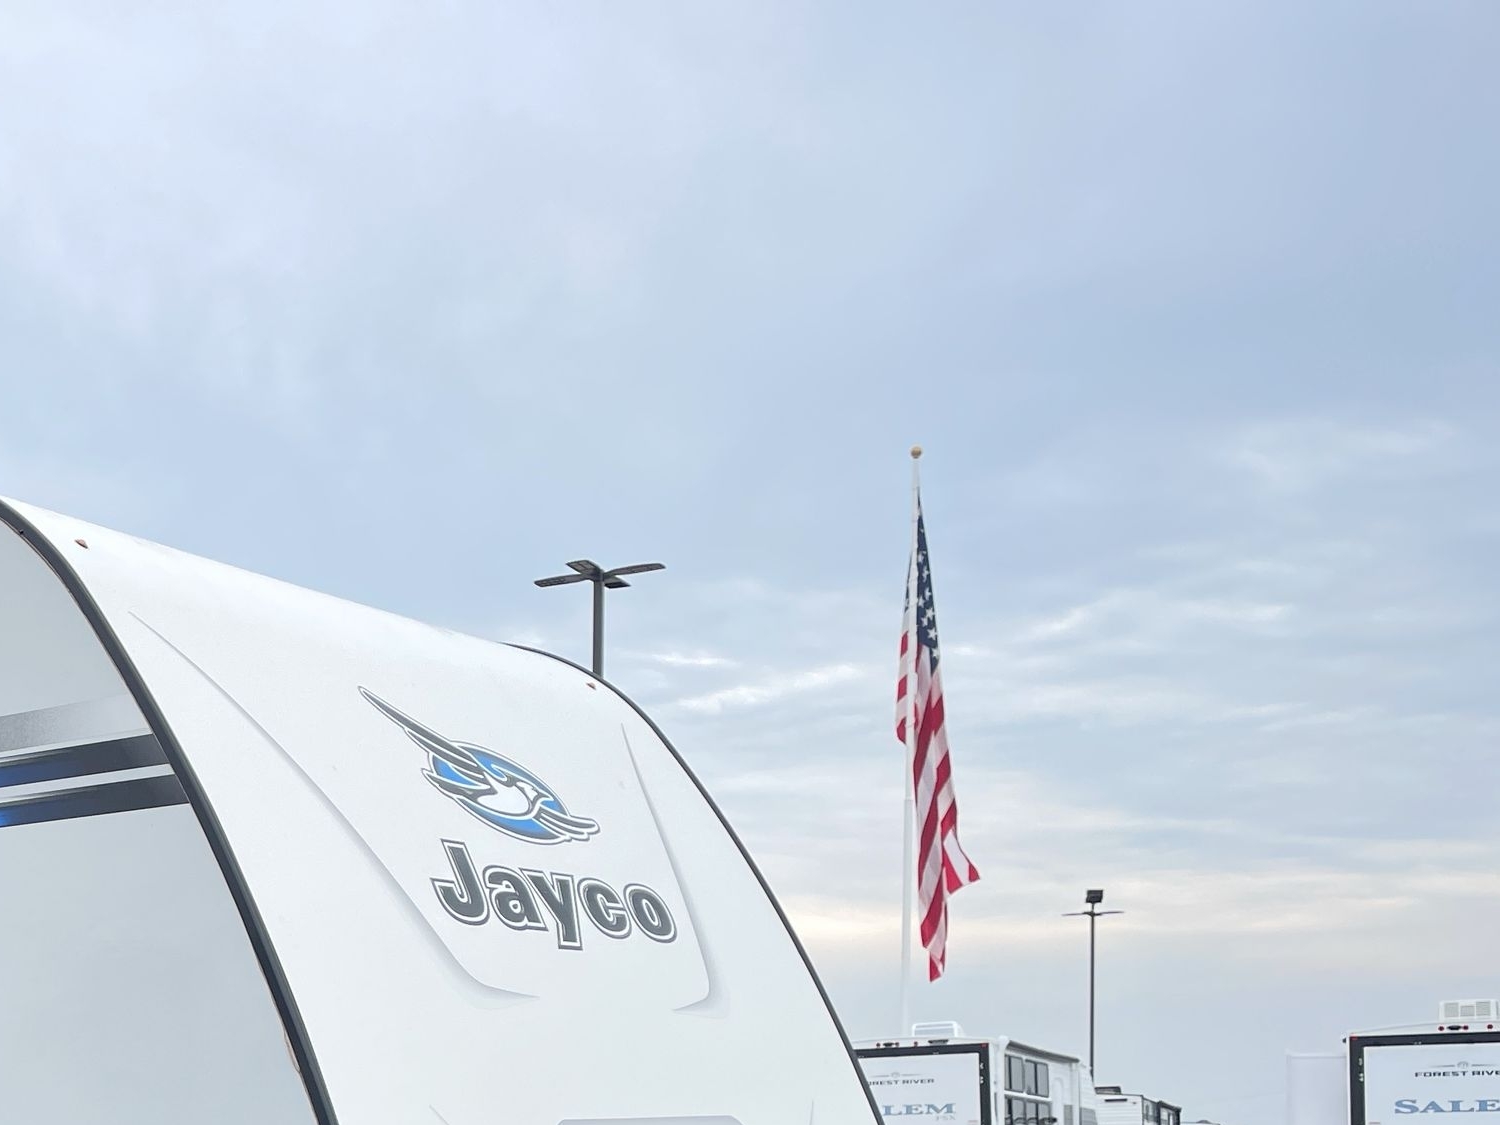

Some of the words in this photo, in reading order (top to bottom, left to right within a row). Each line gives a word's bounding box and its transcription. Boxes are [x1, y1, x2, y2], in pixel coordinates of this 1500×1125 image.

[429, 838, 678, 951] Jayco
[883, 1103, 956, 1115] LEM
[1394, 1099, 1500, 1114] SALE
